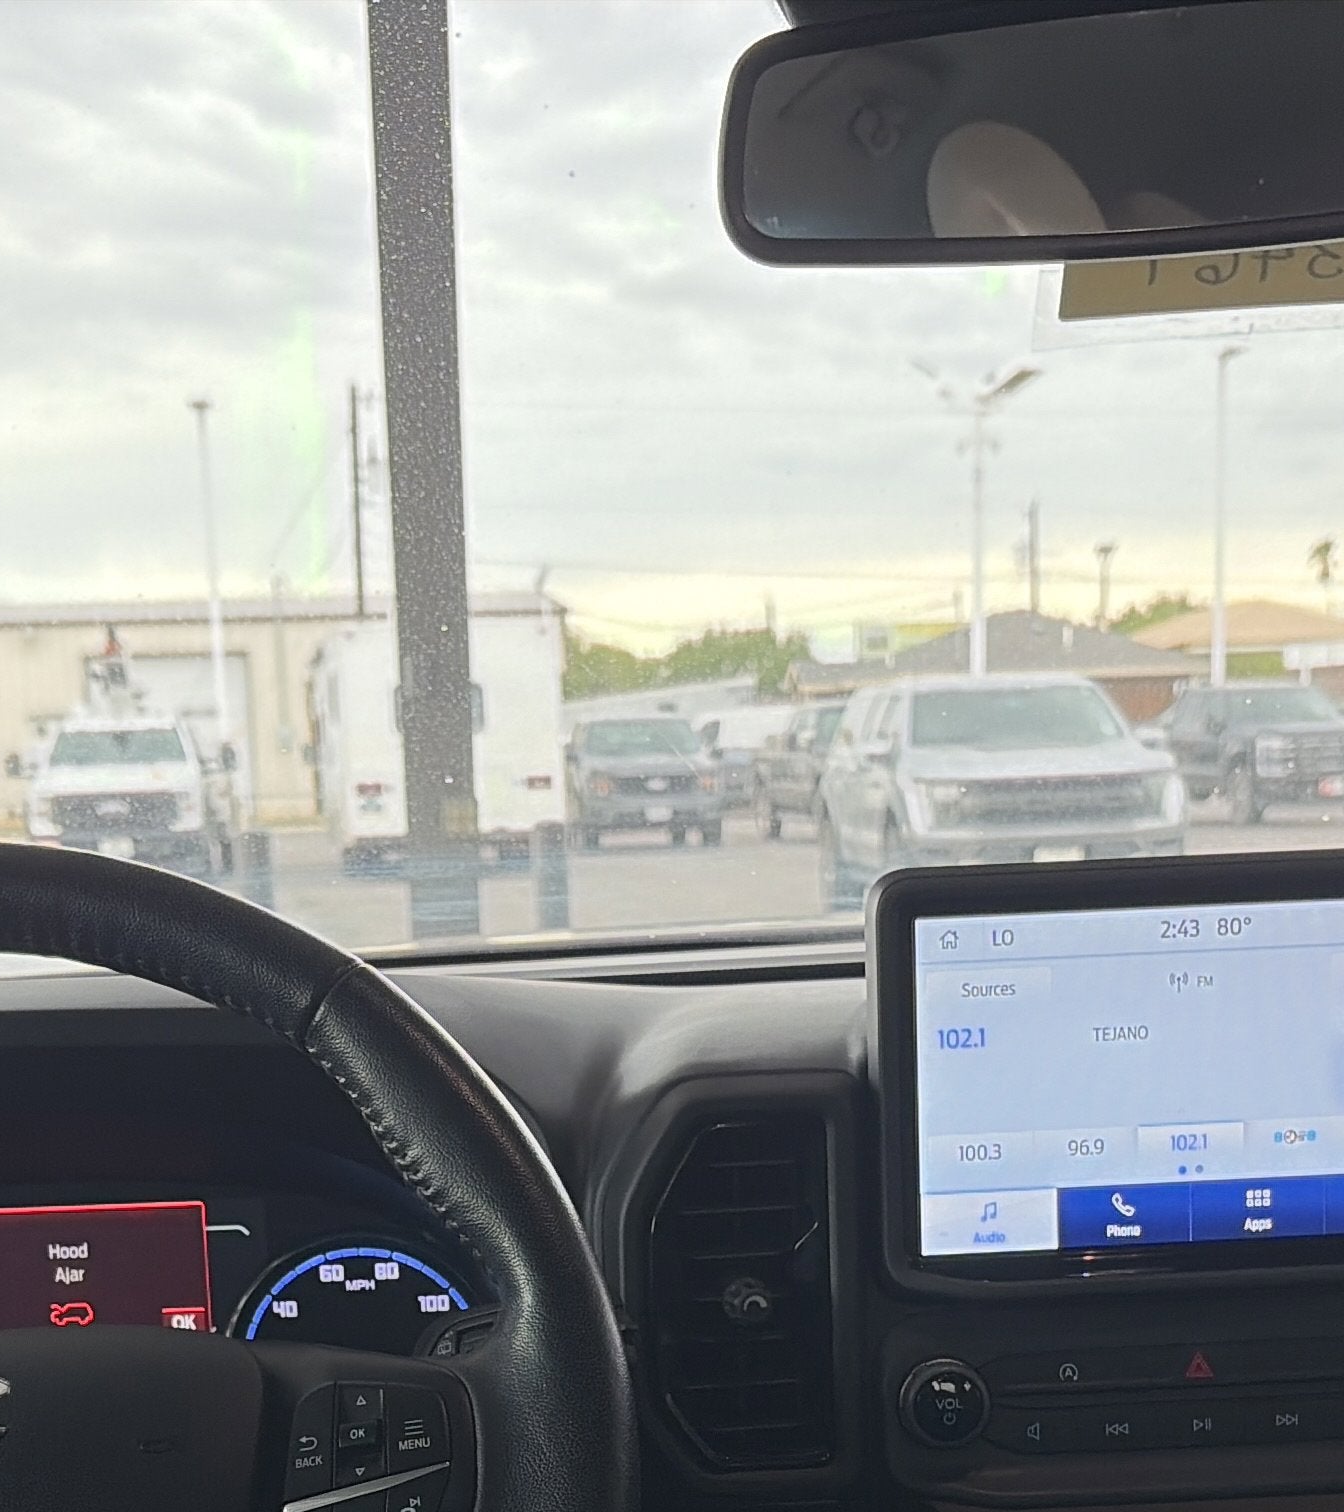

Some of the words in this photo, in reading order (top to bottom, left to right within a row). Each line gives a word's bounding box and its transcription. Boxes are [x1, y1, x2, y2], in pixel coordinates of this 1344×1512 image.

[1160, 919, 1200, 939] 2:43
[1216, 916, 1252, 937] 80°
[992, 929, 1014, 947] LO
[961, 982, 1016, 998] Sources
[1196, 975, 1214, 988] FM
[937, 1027, 986, 1050] 102.1
[1092, 1025, 1149, 1042] TEJANO
[1067, 1138, 1105, 1157] 96.9
[1170, 1133, 1208, 1151] 102.1
[958, 1143, 1002, 1162] 100.3
[1106, 1224, 1141, 1238] Phone
[1243, 1217, 1273, 1232] Apps
[972, 1231, 1006, 1244] Audio
[48, 1242, 89, 1260] Hood
[54, 1266, 85, 1284] Ajar
[319, 1264, 345, 1283] 60
[374, 1261, 400, 1280] 80
[345, 1279, 376, 1292] MPH
[271, 1300, 299, 1318] 40
[417, 1294, 450, 1313] 100
[171, 1313, 197, 1330] OK
[935, 1398, 964, 1410] VOL
[349, 1428, 366, 1440] OK
[398, 1436, 431, 1451] MENU
[295, 1455, 323, 1469] BACK
